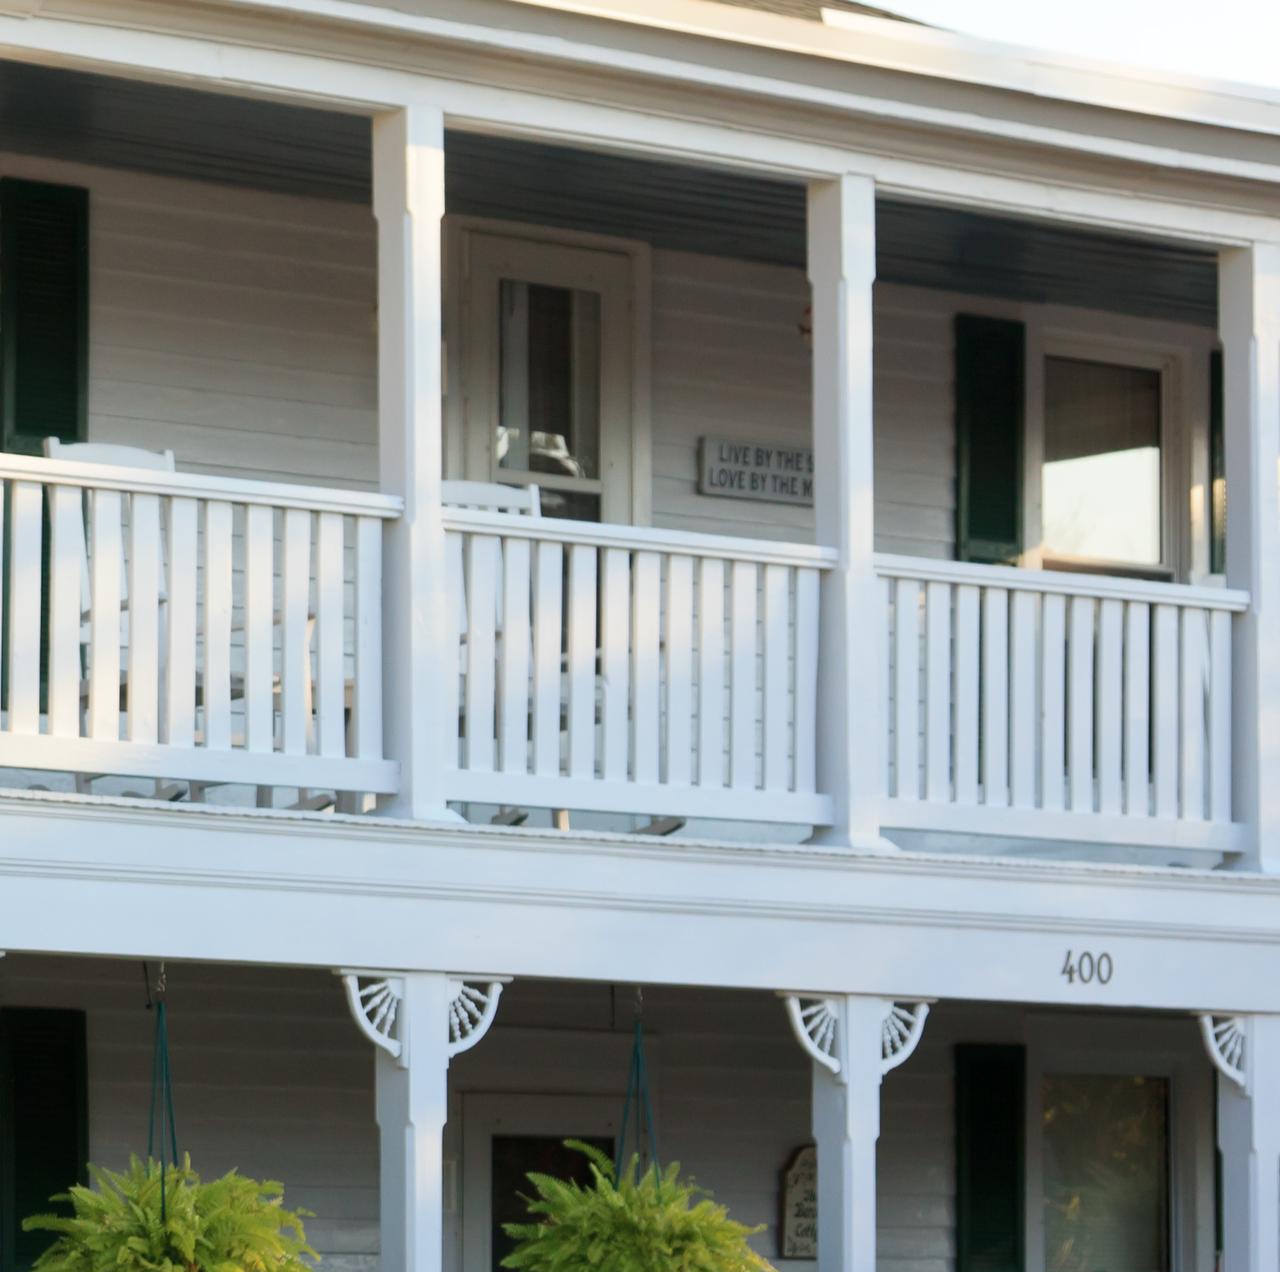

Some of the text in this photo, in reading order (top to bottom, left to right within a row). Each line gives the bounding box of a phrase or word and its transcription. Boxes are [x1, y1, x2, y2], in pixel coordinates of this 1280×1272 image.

[719, 444, 750, 467] LIVE
[755, 448, 773, 468] BY
[777, 450, 803, 473] THE
[709, 467, 745, 490] LOVE
[750, 472, 767, 492] BY
[772, 474, 798, 496] THE
[1061, 949, 1113, 985] 400
